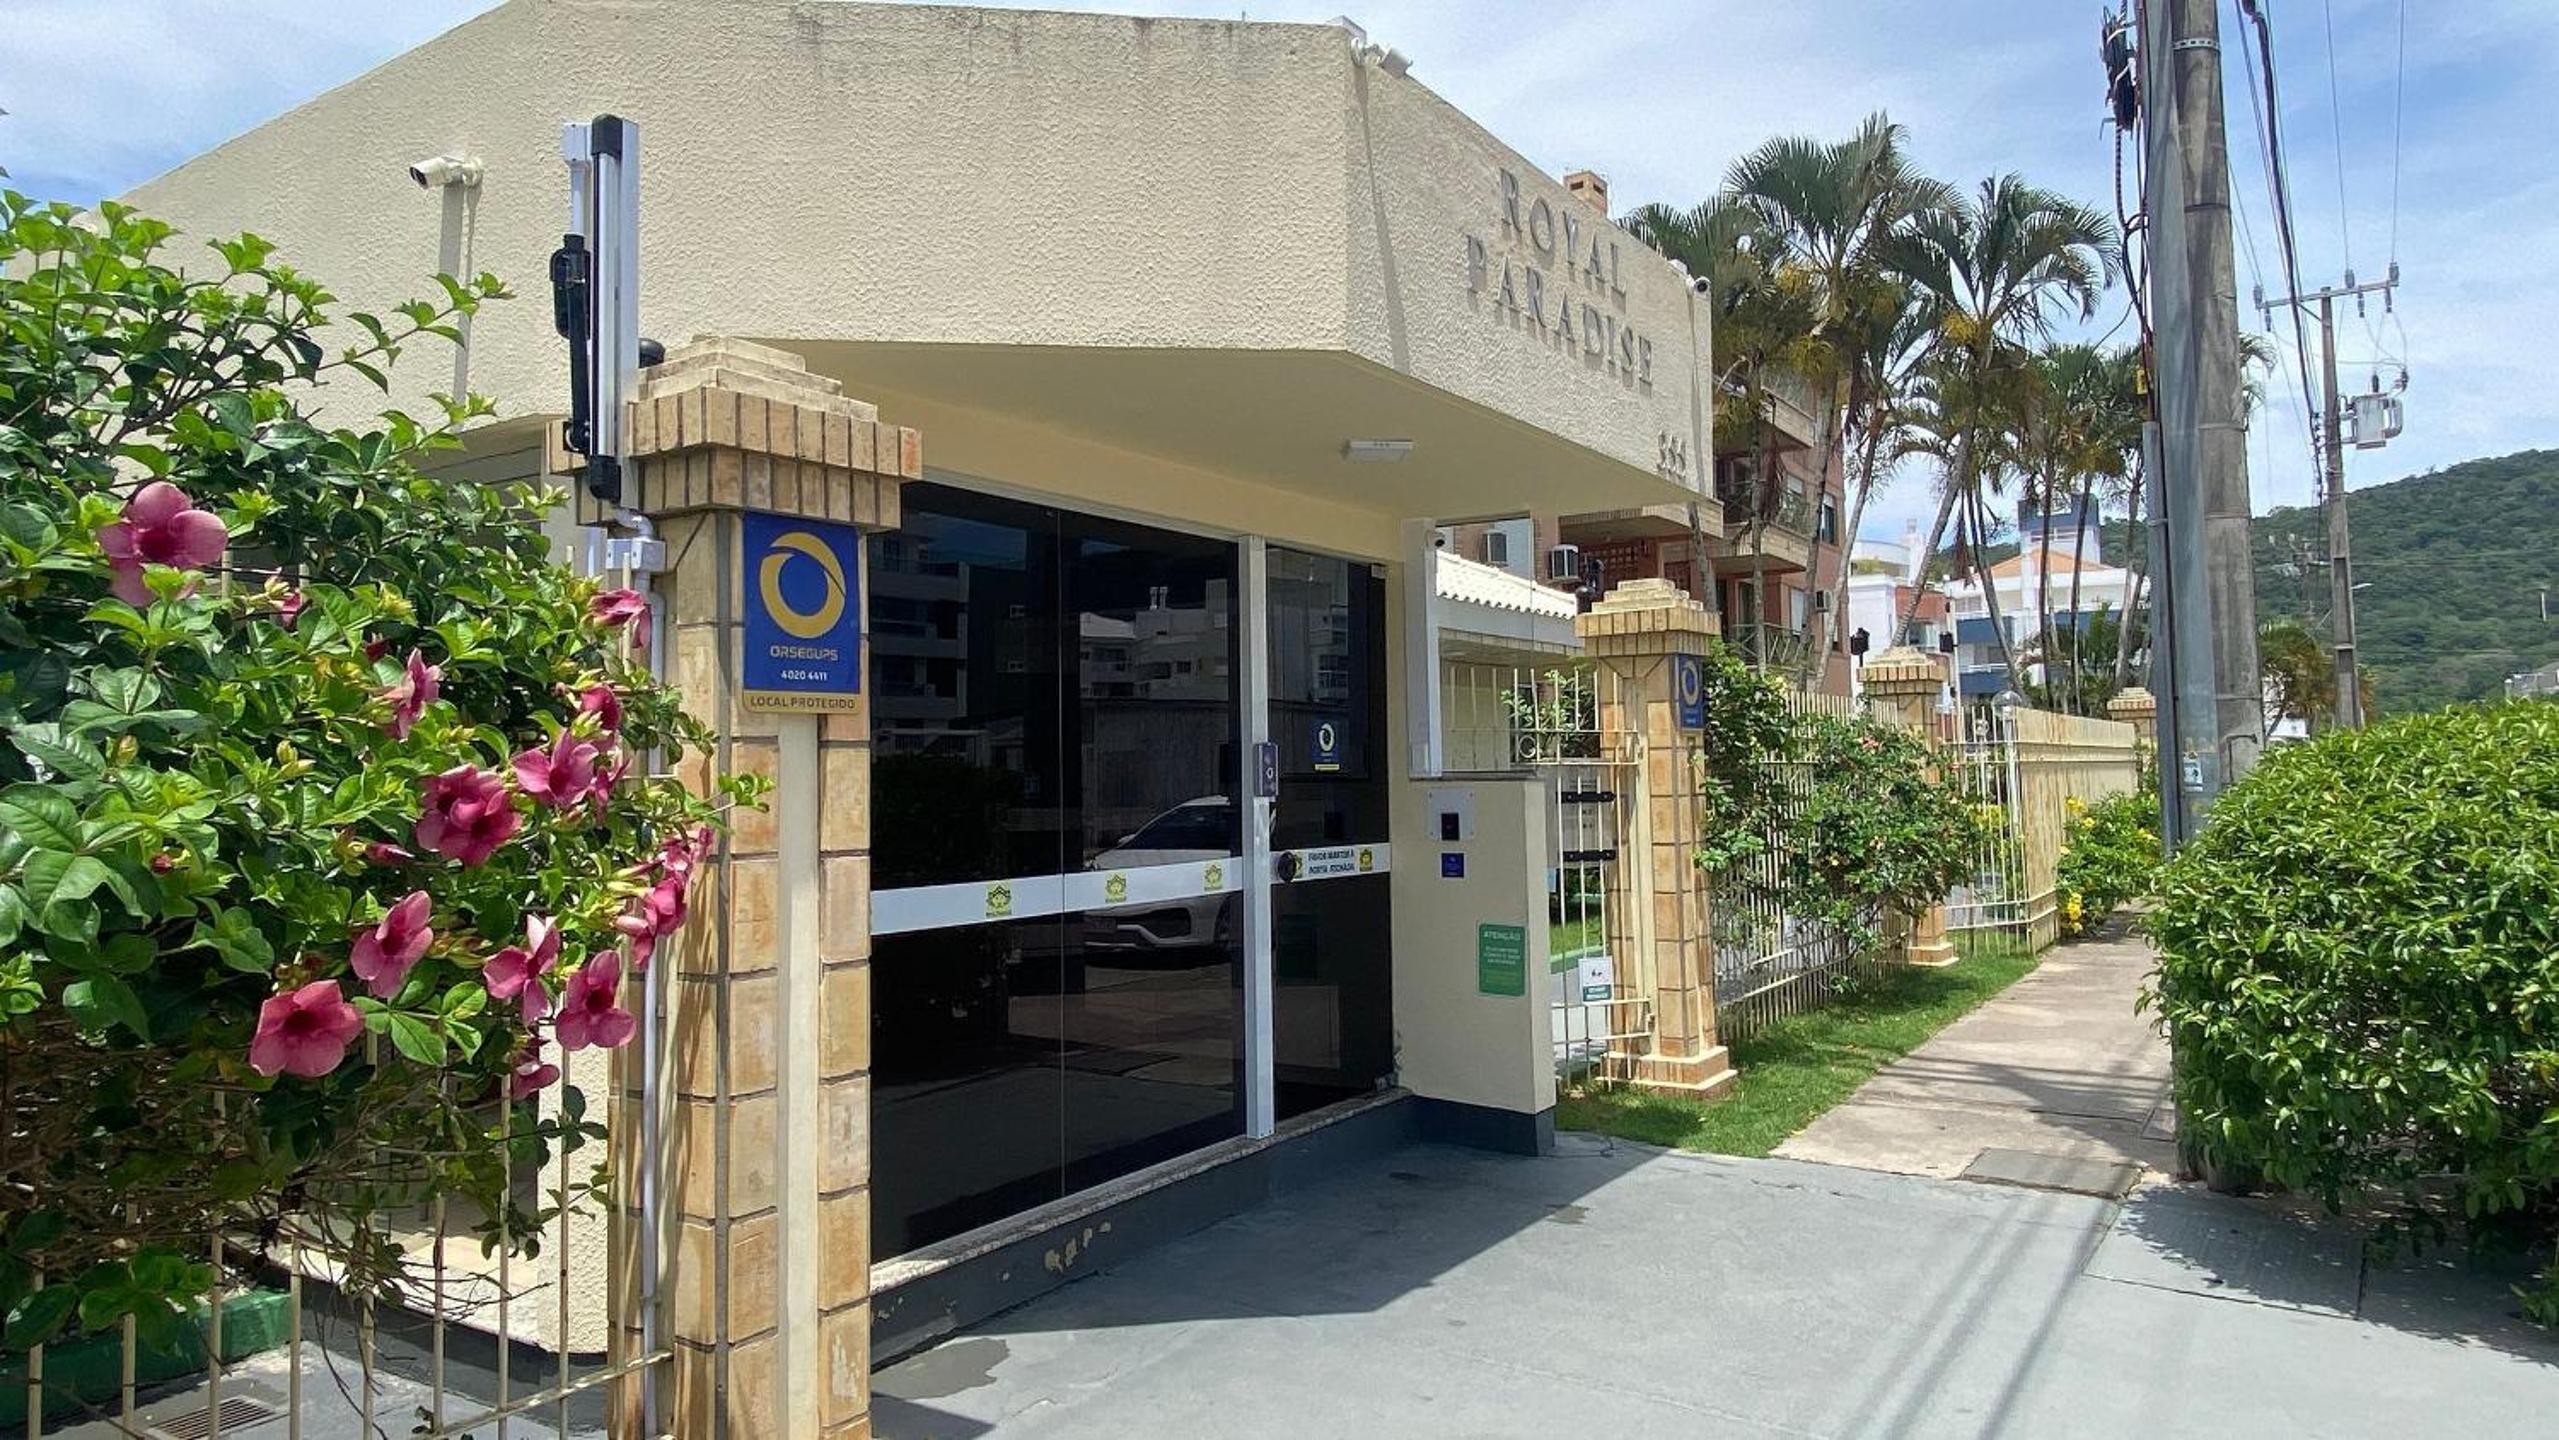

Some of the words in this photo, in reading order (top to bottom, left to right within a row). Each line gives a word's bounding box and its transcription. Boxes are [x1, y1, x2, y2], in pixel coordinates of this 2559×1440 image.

[1500, 167, 1626, 304] ROYAL
[1466, 234, 1653, 386] PARADISE
[770, 644, 839, 661] ORSEGUPS
[781, 670, 806, 680] 4020
[808, 672, 828, 682] 4411
[750, 696, 788, 707] LOCAL
[790, 697, 855, 709] PROTEGIDO
